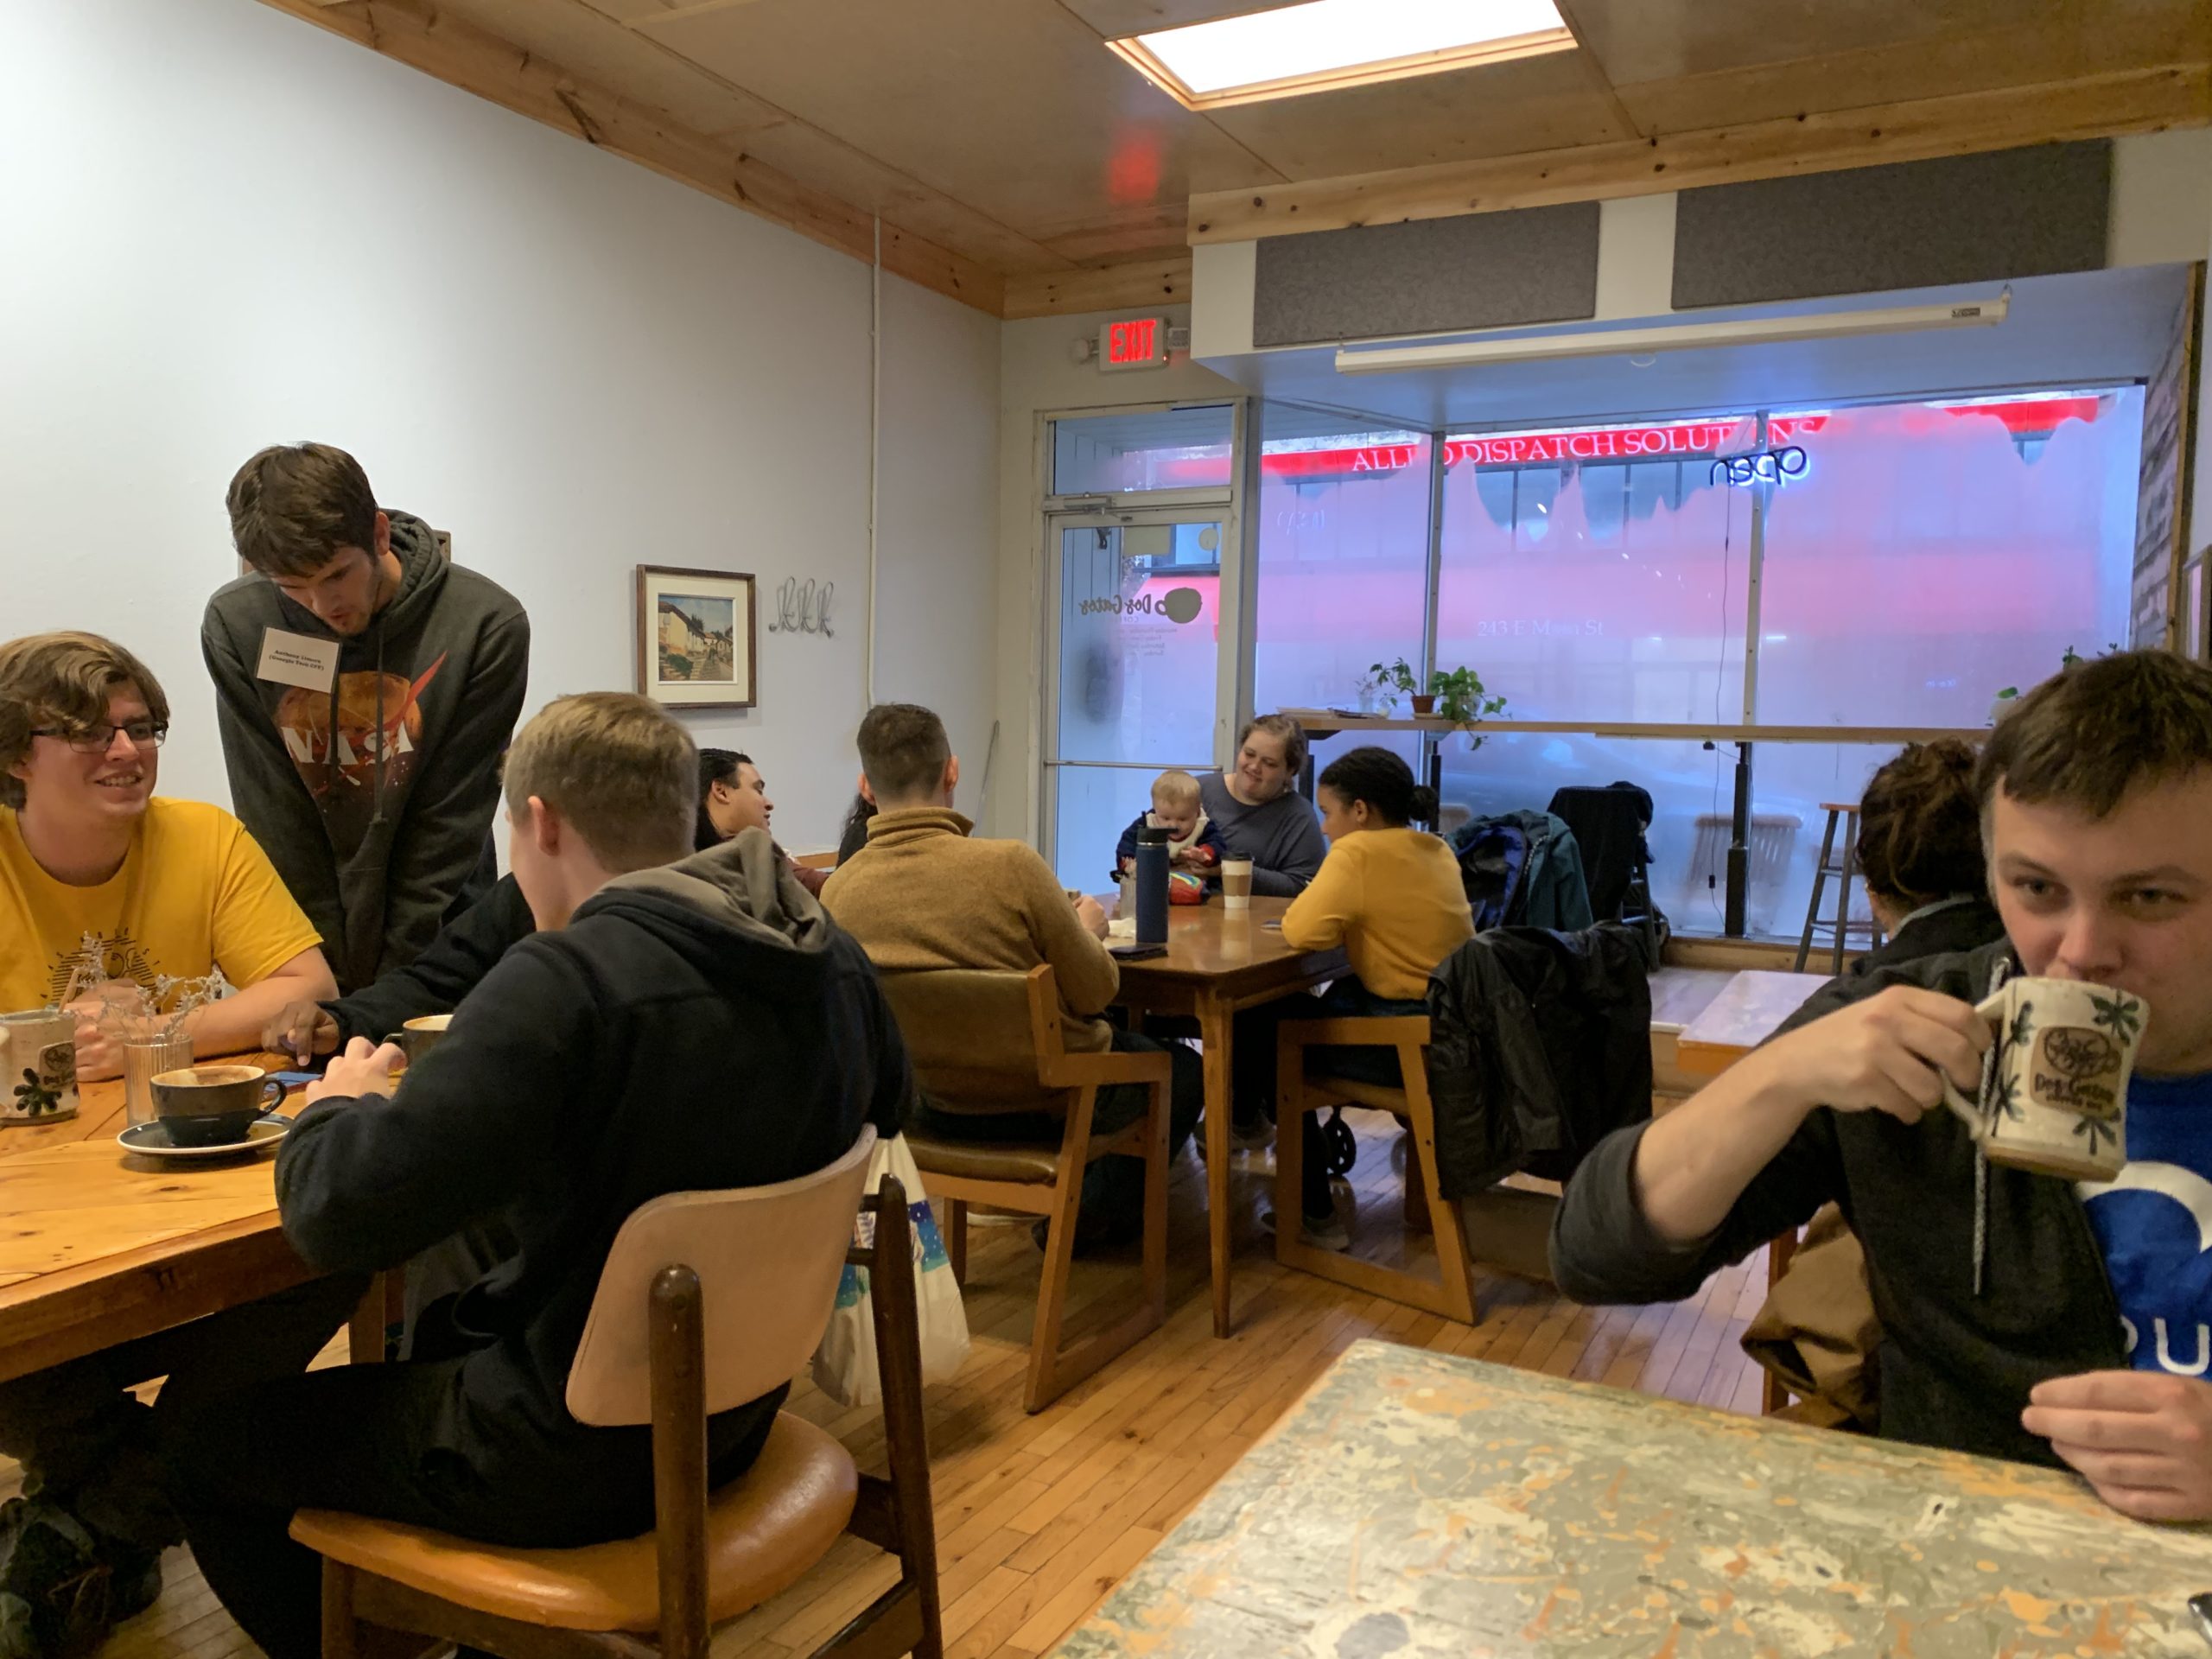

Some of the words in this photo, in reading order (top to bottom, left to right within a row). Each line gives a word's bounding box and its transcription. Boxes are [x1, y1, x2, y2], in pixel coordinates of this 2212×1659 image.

[1109, 318, 1157, 364] EXIT
[1351, 446, 1454, 472] ALLI
[1461, 434, 1618, 463] DISPATCH
[1624, 420, 1815, 454] SOLUTNS
[1478, 620, 1507, 637] 243
[1513, 619, 1527, 636] E
[1585, 619, 1604, 637] St
[281, 720, 414, 766] NASA
